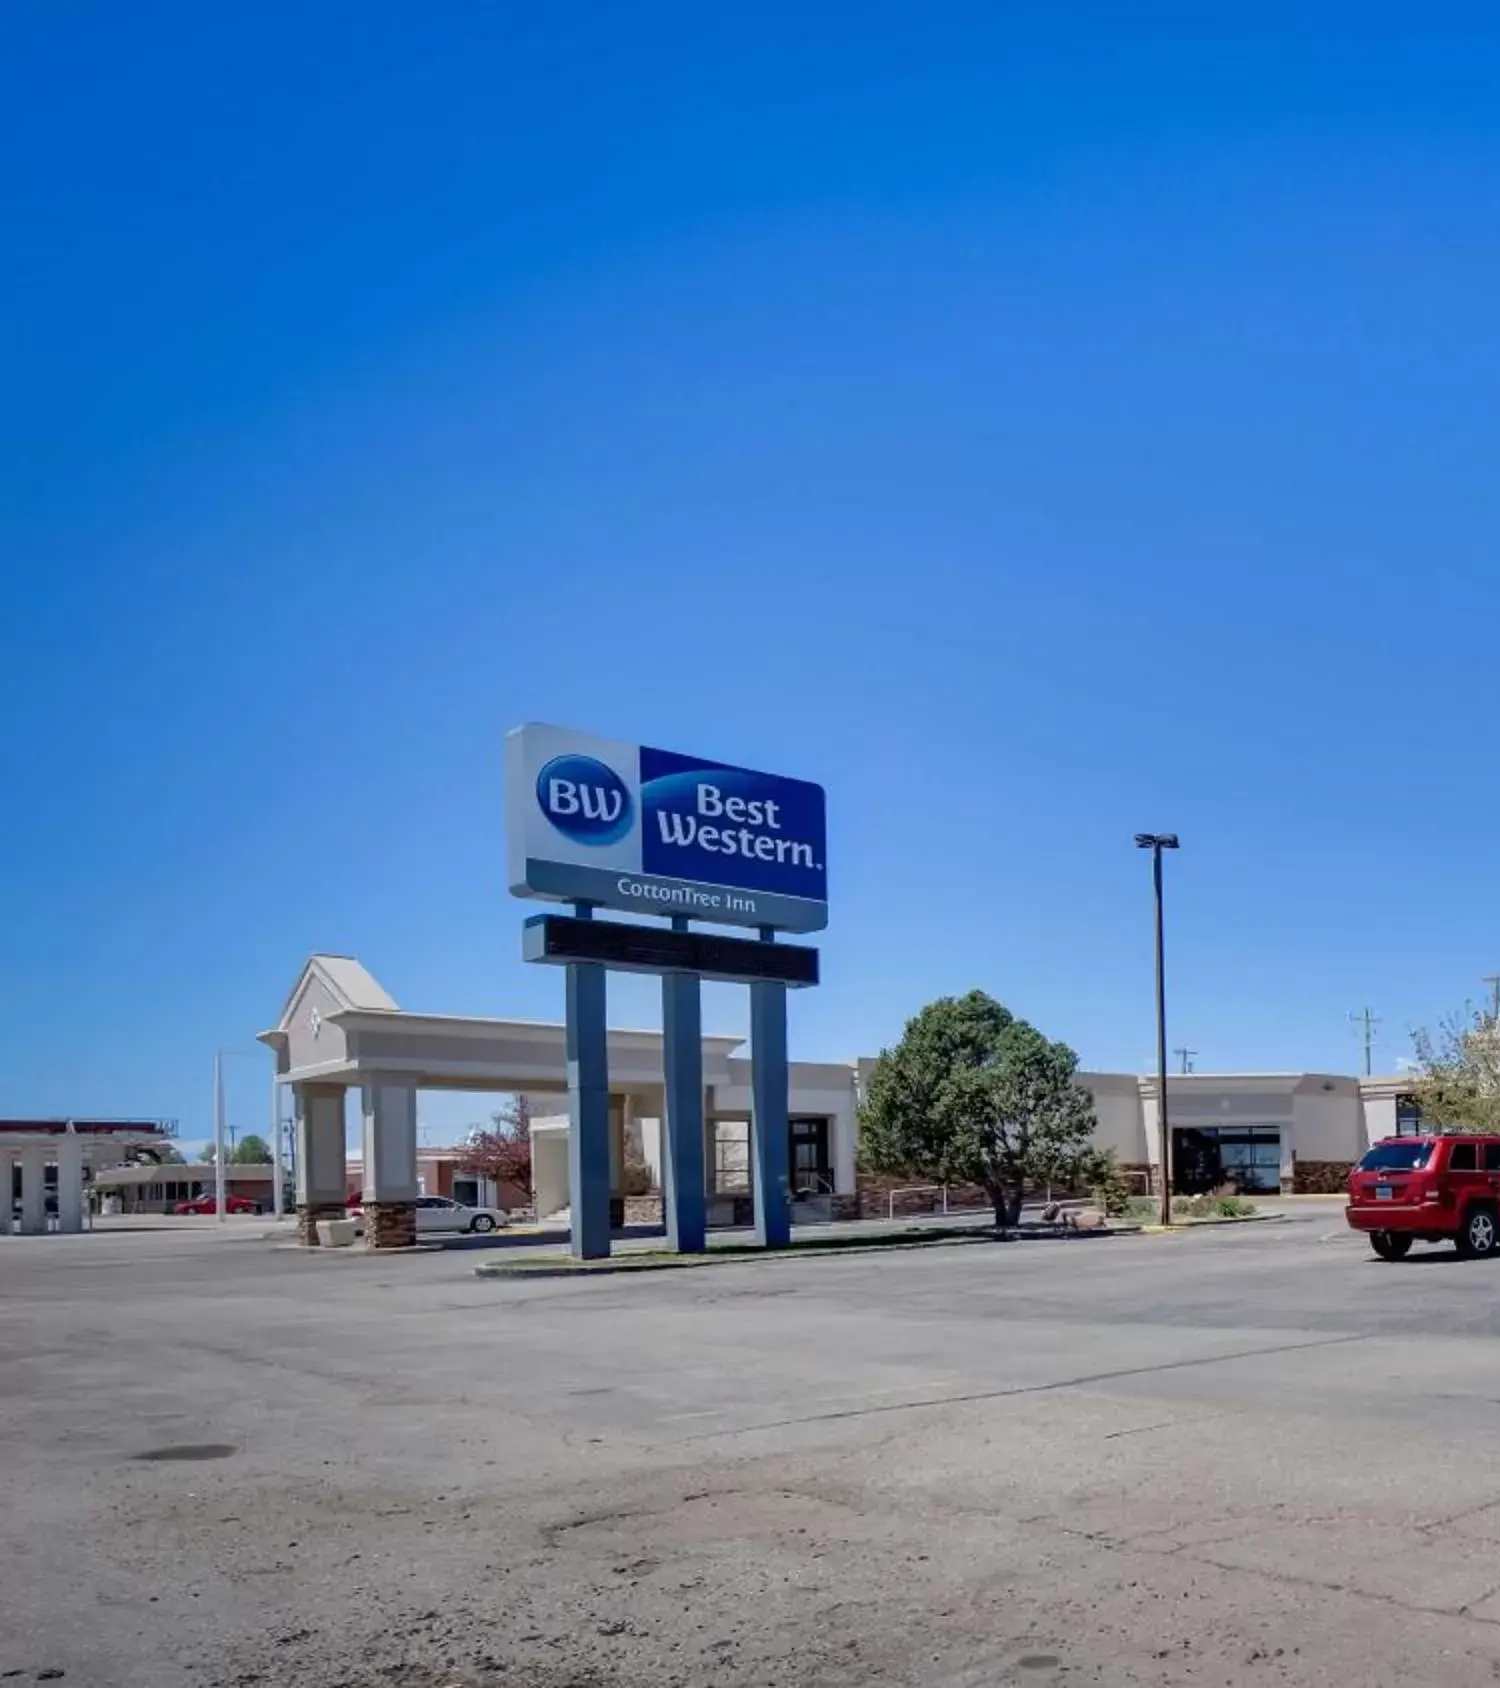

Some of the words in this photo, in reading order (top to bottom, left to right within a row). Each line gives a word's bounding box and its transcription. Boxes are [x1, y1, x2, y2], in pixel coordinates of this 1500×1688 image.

[549, 779, 622, 822] BW
[697, 783, 780, 829] Best
[617, 878, 721, 908] CottonTree
[726, 894, 756, 913] Inn
